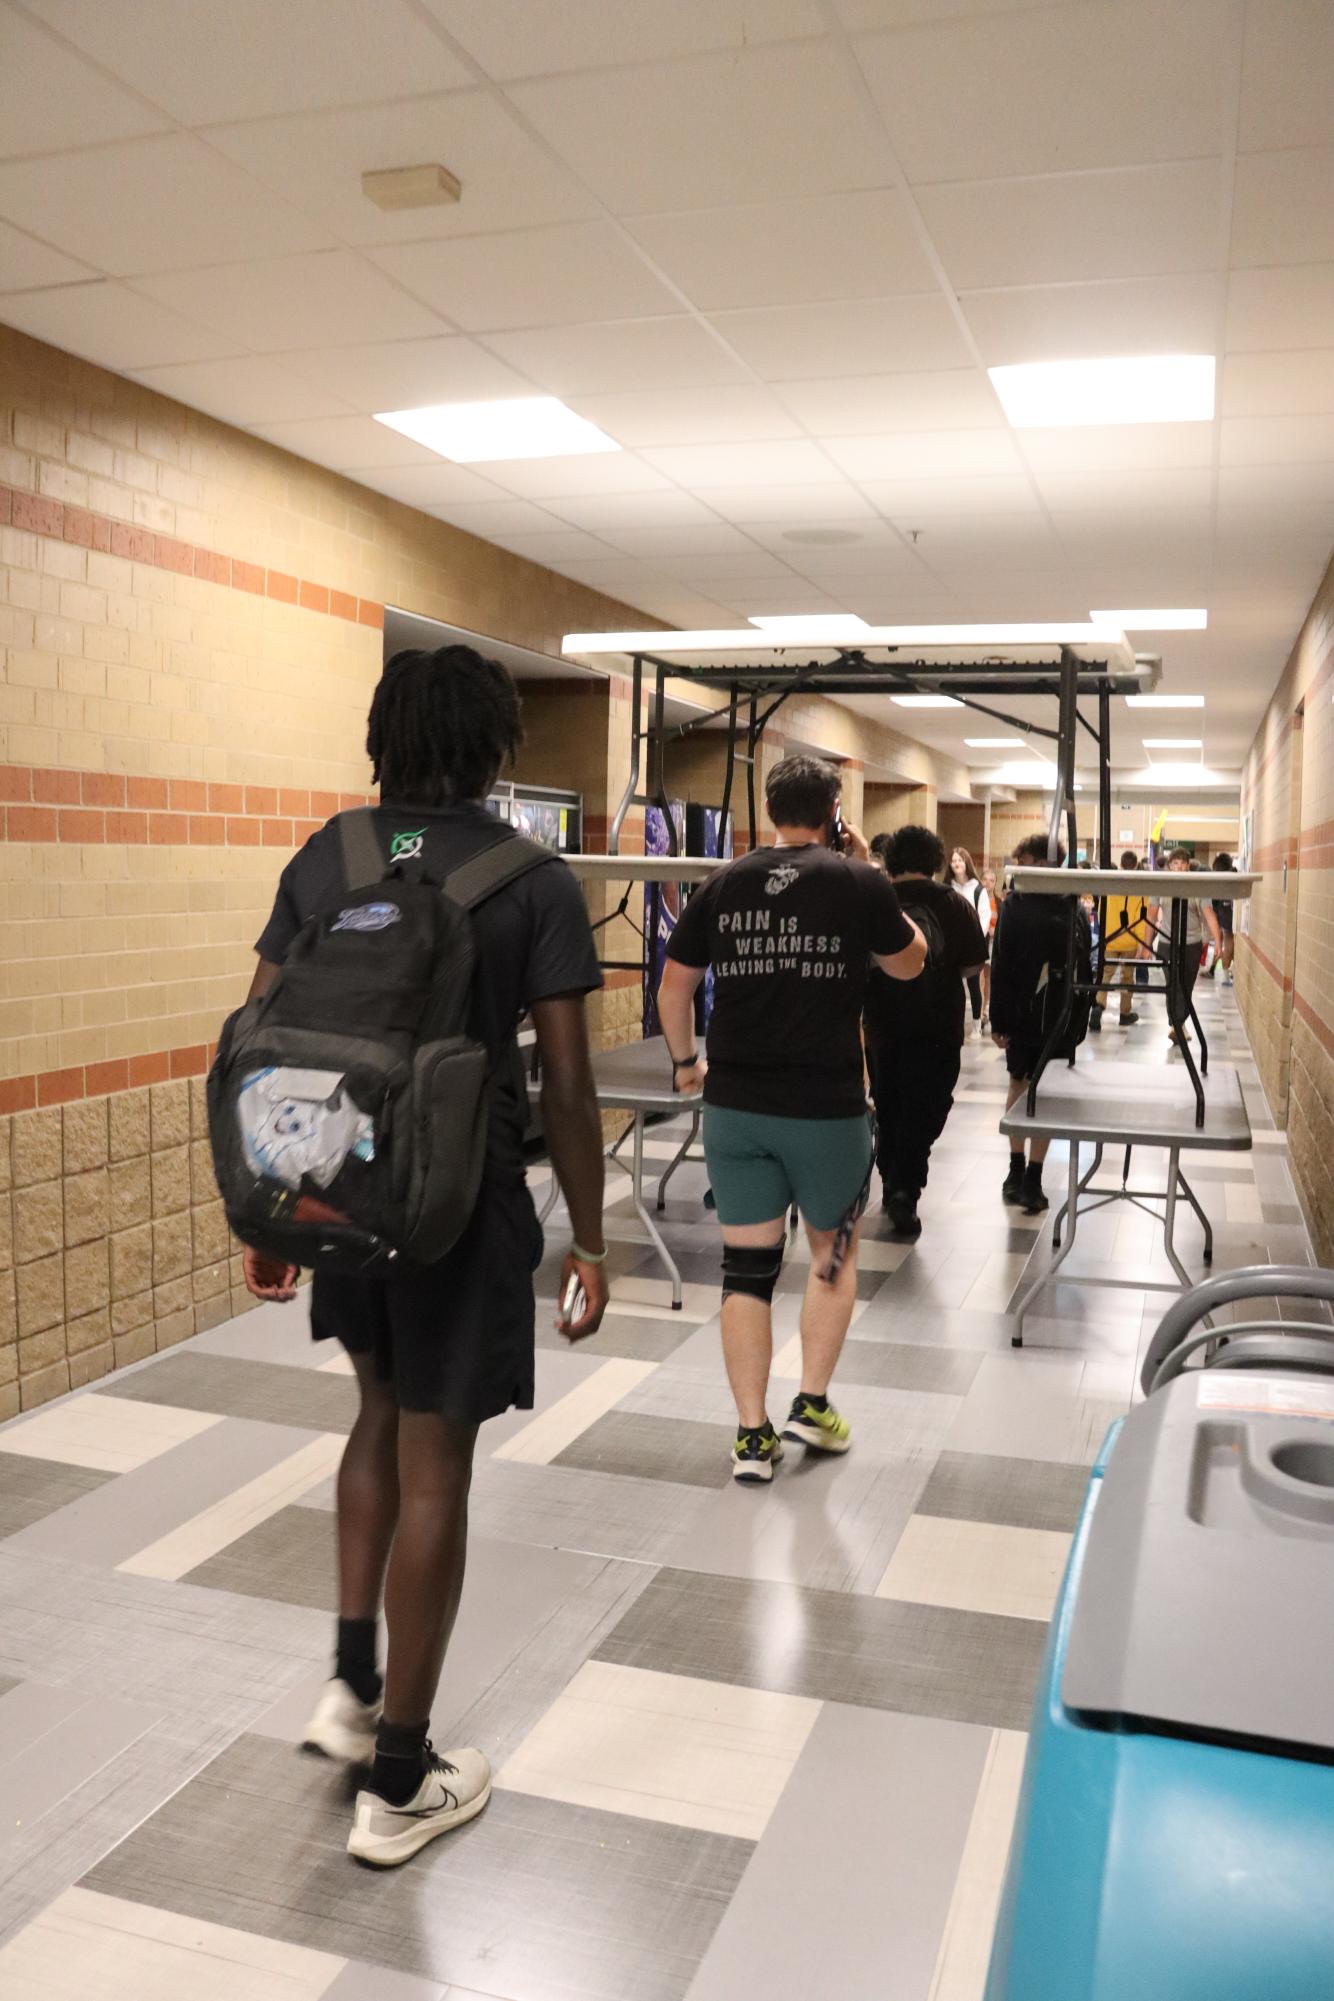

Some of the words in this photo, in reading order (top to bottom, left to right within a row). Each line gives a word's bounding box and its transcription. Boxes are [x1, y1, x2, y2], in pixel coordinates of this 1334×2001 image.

[718, 910, 771, 933] PAIN
[780, 916, 798, 934] IS
[735, 935, 841, 956] WEAKNESS
[716, 958, 775, 977] LEAVING
[779, 957, 797, 970] THE
